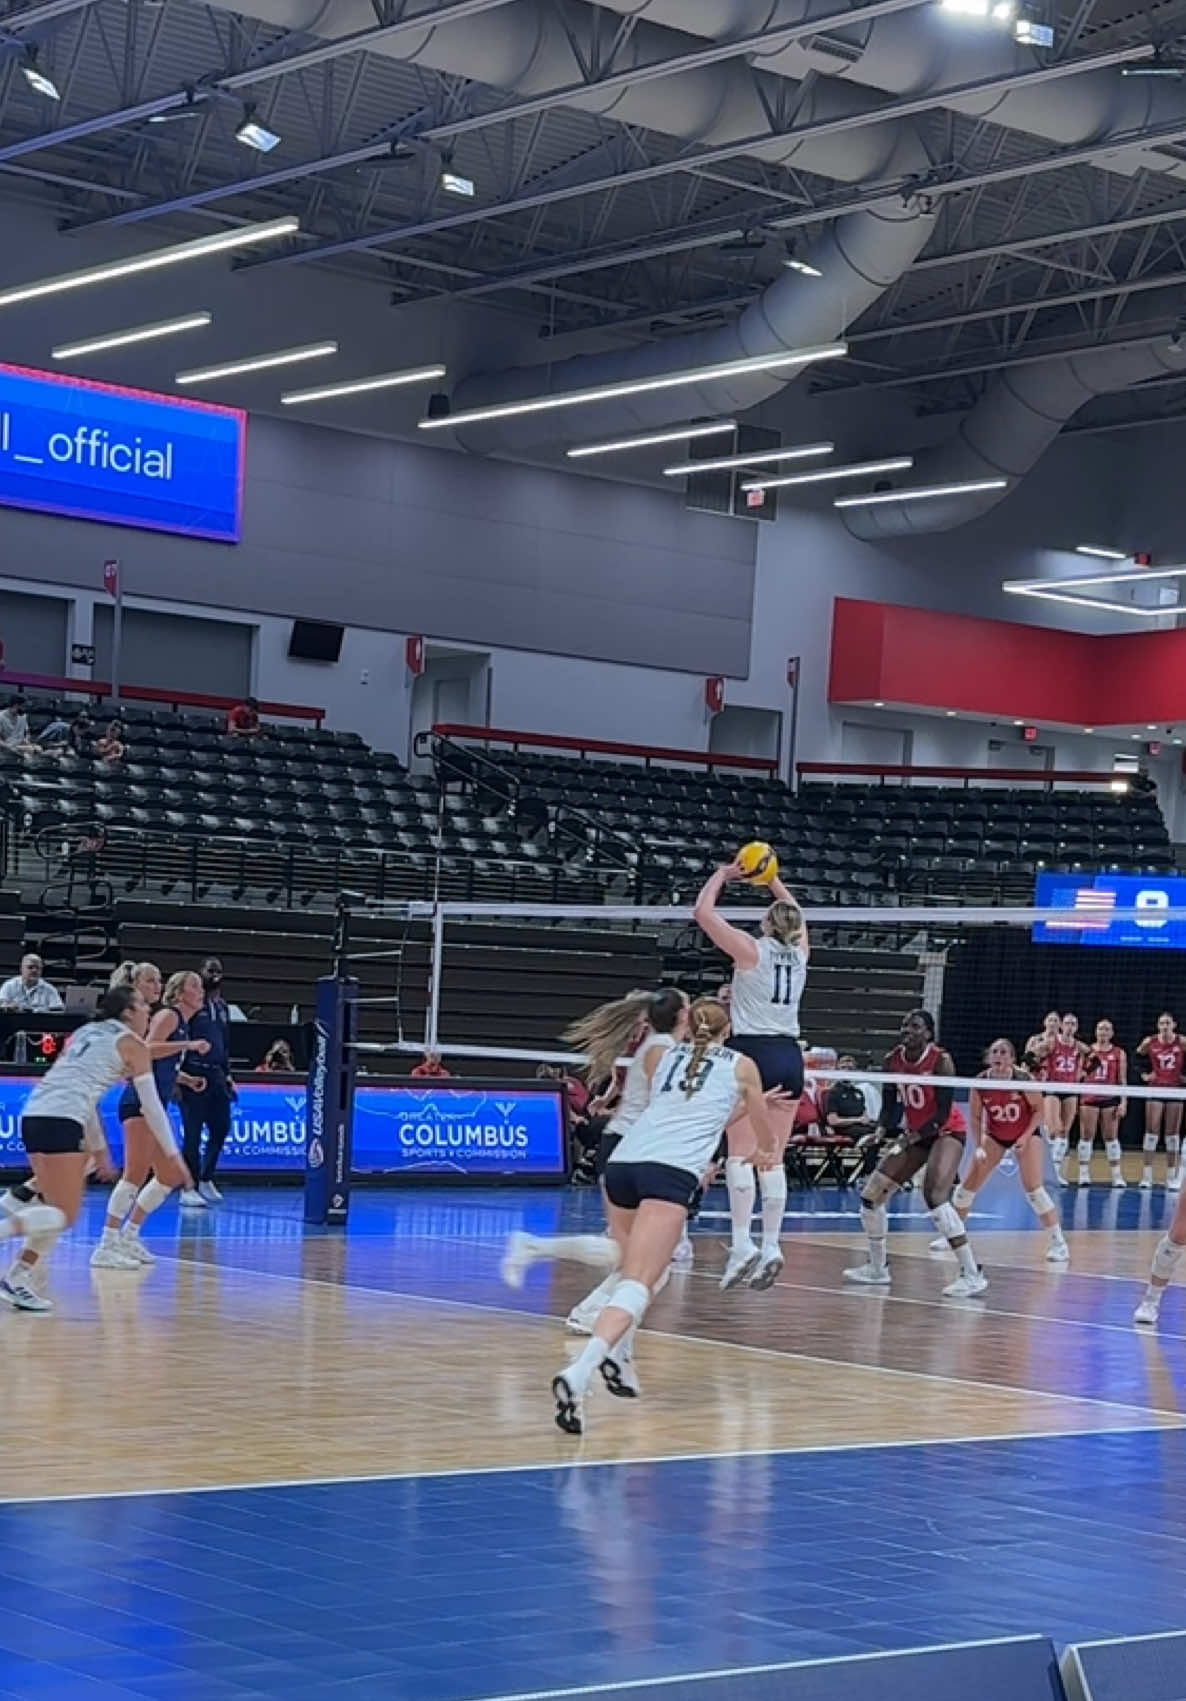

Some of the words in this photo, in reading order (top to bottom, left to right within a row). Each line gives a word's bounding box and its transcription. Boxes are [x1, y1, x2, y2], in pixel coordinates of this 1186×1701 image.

[771, 964, 792, 1005] 11
[990, 1103, 1019, 1122] 20
[399, 1123, 529, 1147] COLUMBUS
[401, 1147, 446, 1158] SPORTS
